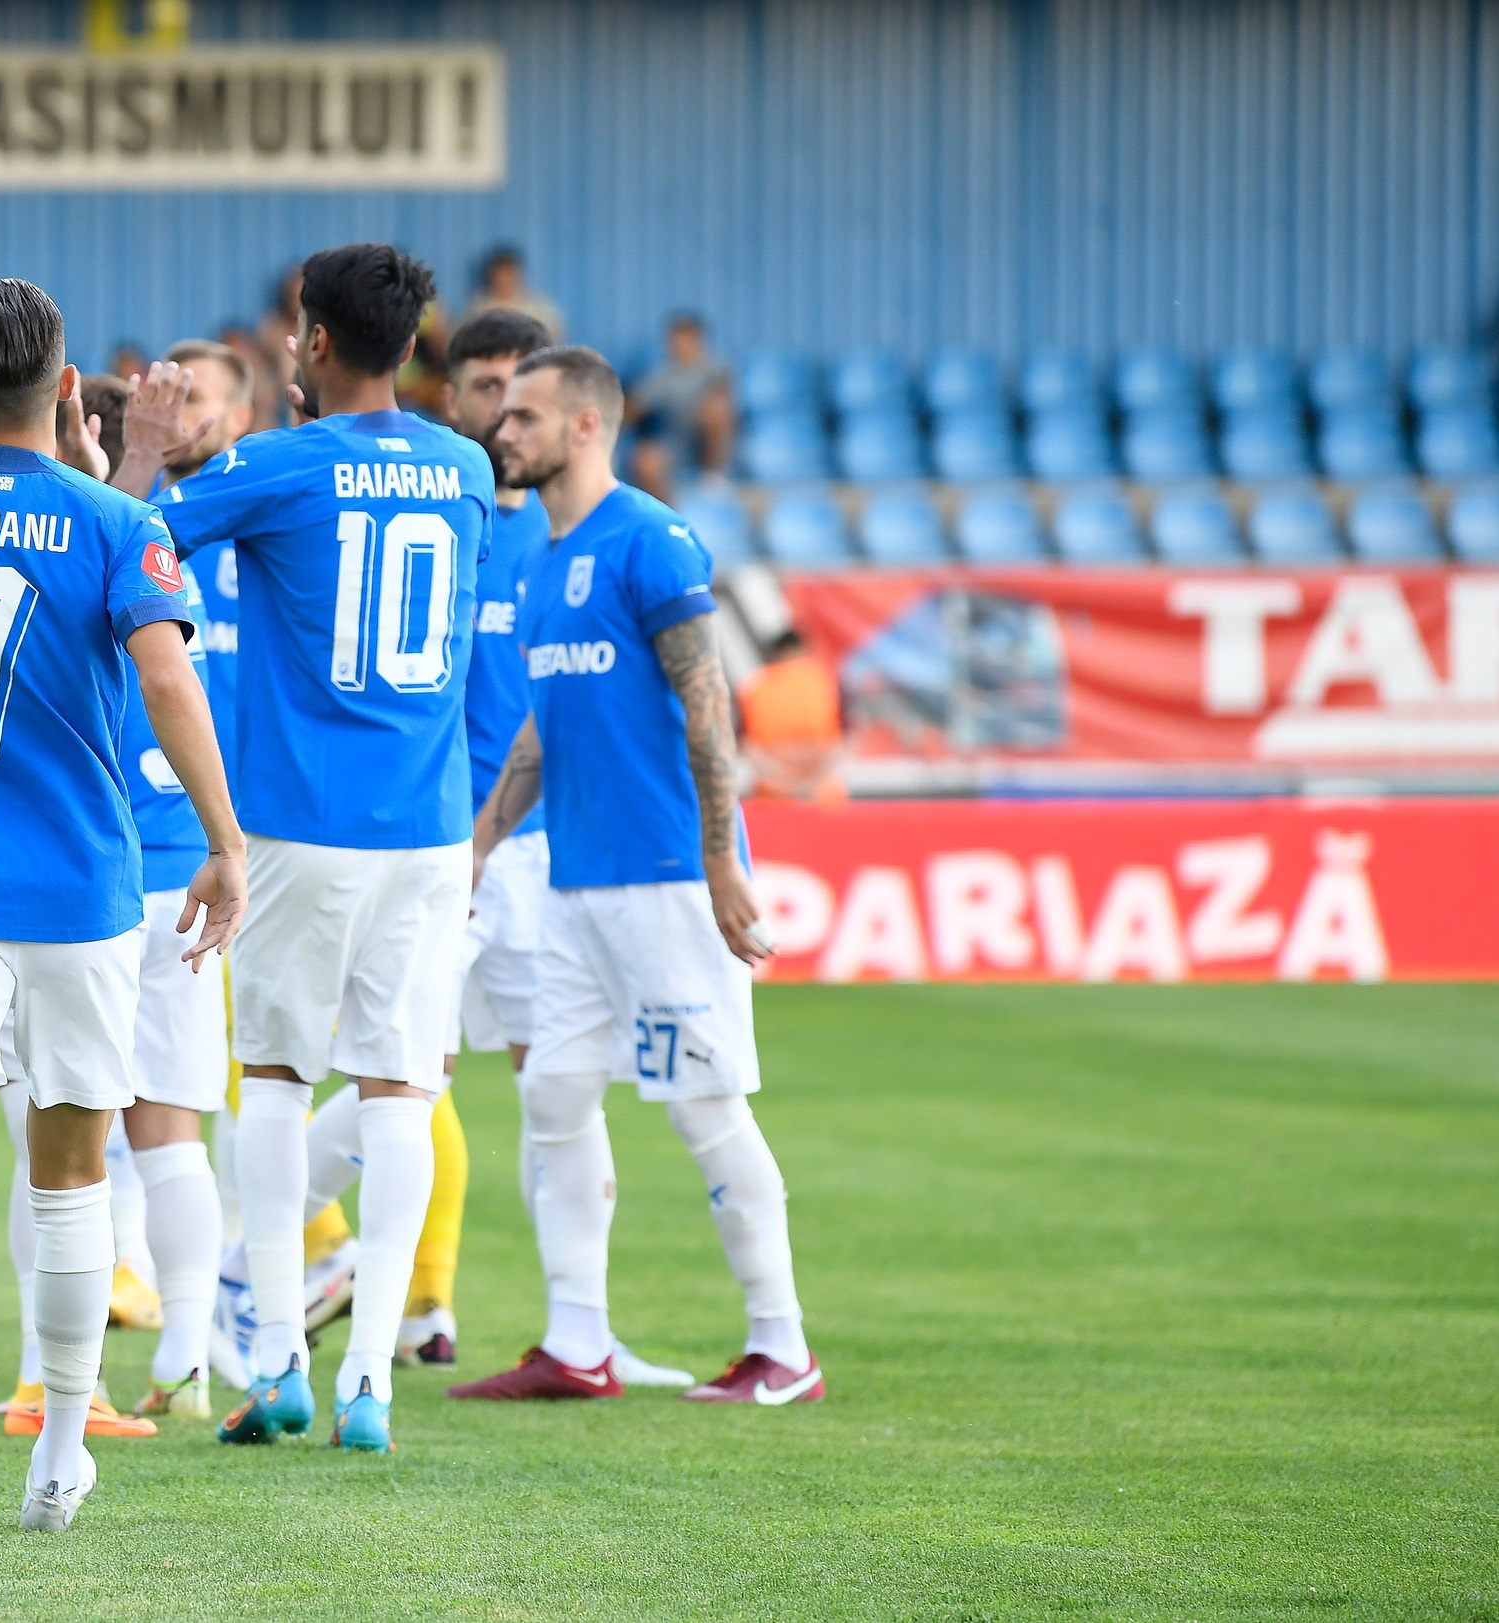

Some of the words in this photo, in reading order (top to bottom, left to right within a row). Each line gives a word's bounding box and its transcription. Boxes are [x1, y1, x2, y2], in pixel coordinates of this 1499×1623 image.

[333, 462, 462, 500] BAIARAM
[330, 510, 459, 694] 10
[635, 1018, 677, 1082] 27
